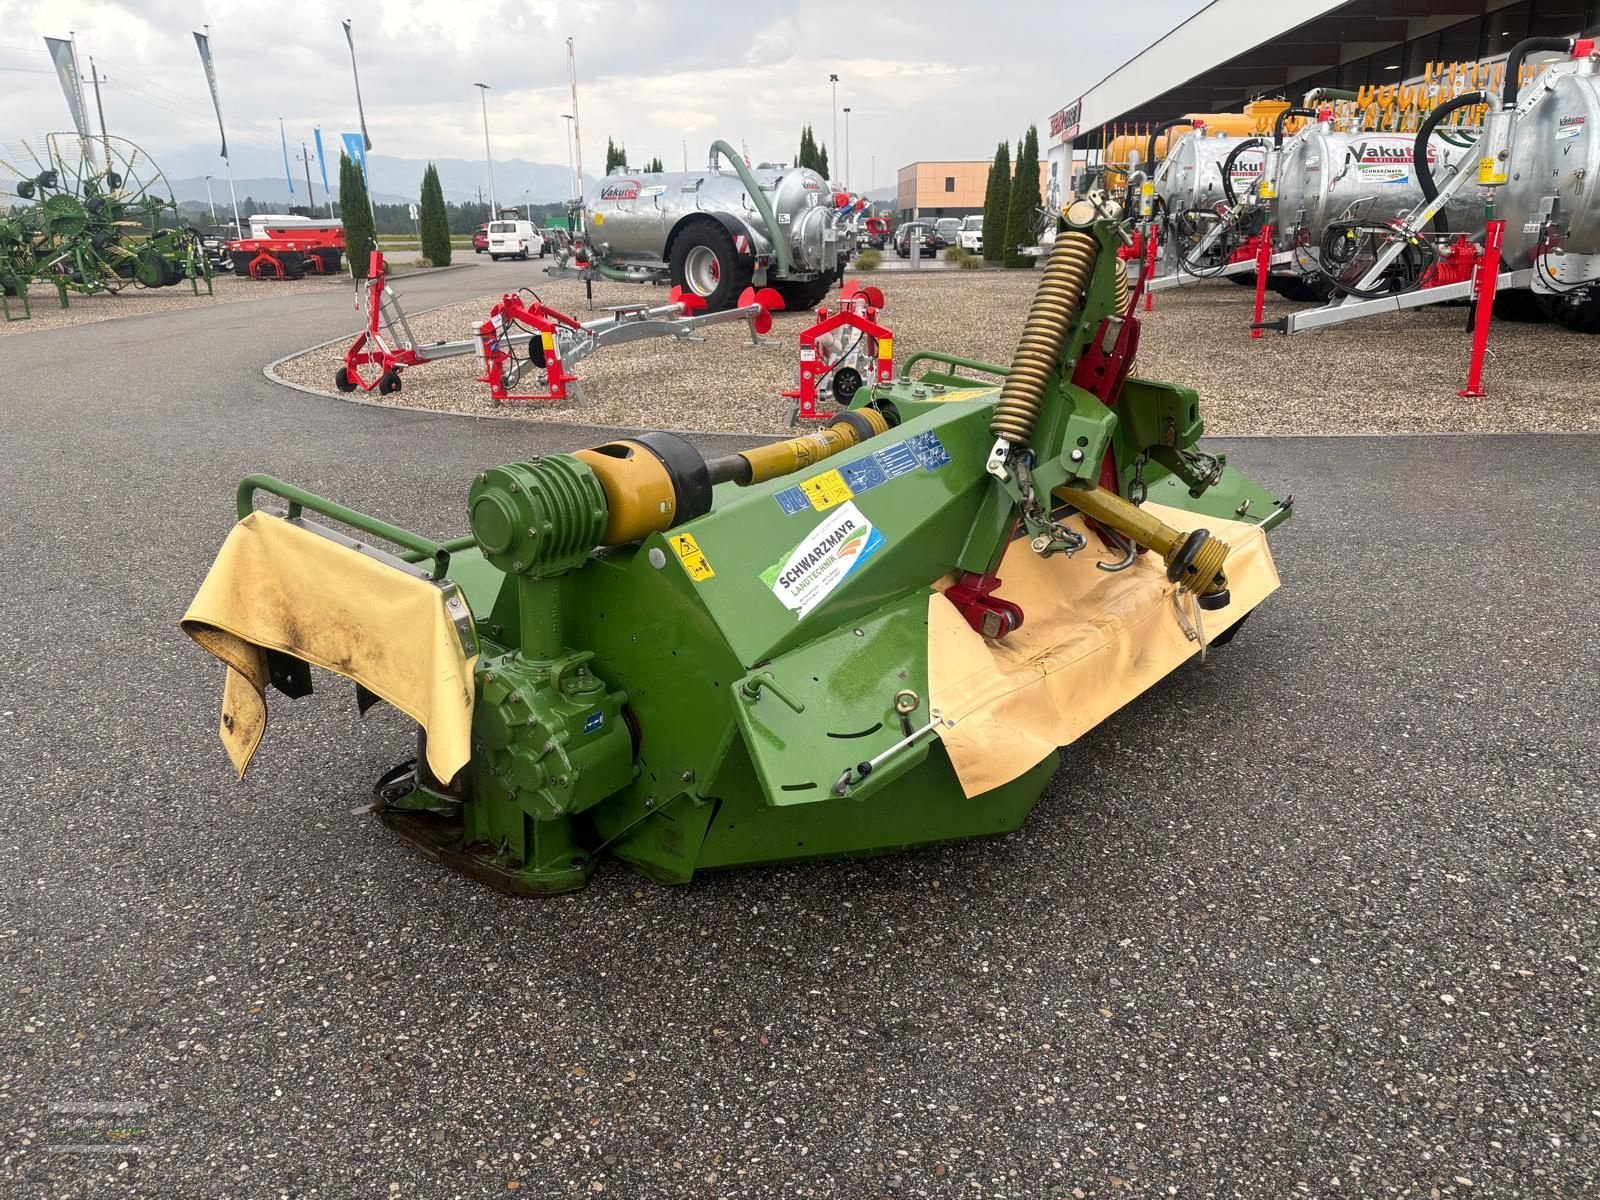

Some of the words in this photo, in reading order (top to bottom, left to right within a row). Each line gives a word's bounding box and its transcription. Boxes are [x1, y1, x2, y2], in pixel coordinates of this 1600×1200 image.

[1559, 116, 1586, 126] Vakutec
[1347, 142, 1438, 163] Vakutc
[601, 185, 640, 199] Vakutec
[779, 519, 856, 589] SCHWARZMAYR
[790, 554, 837, 597] LANDTECHNIK
